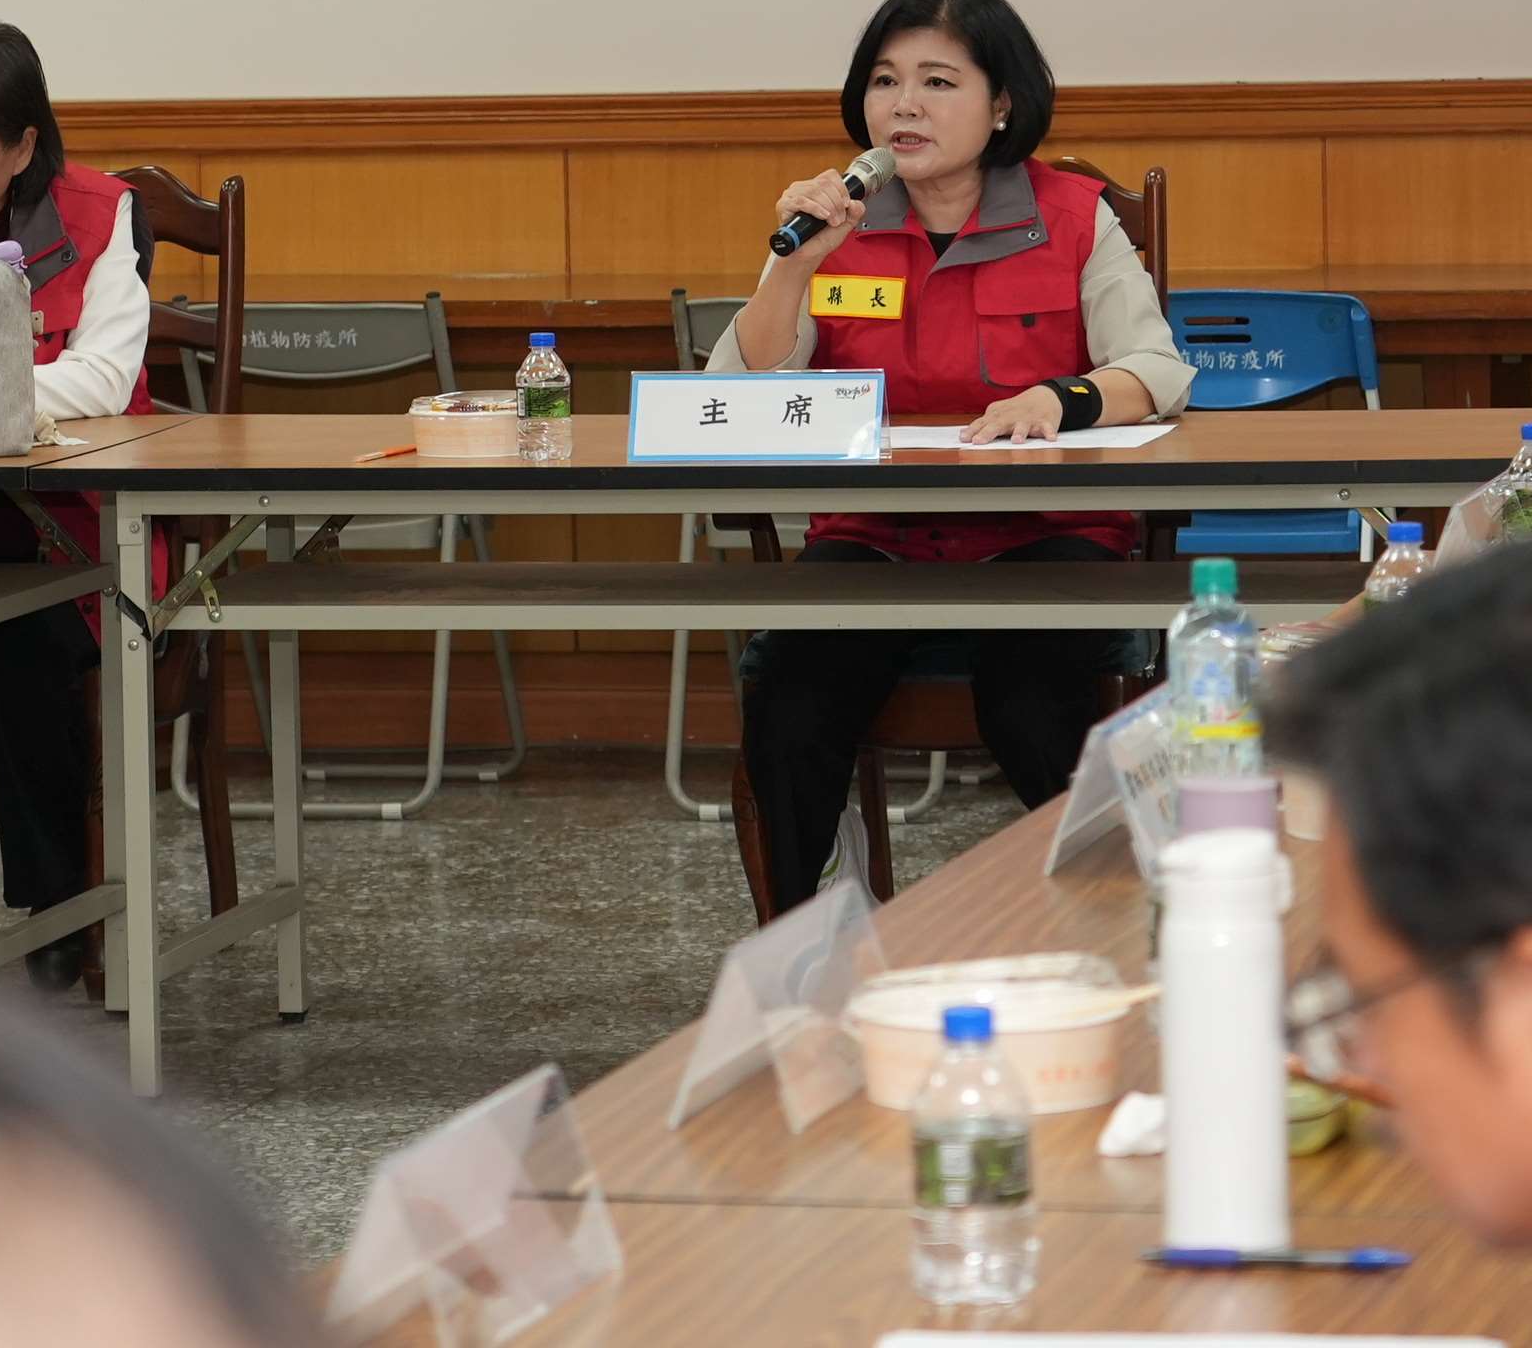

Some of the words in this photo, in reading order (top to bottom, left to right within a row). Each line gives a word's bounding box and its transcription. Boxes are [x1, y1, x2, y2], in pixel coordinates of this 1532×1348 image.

[827, 284, 887, 308] 縣長
[242, 328, 357, 349] 植物防疫所
[699, 394, 813, 428] 主席
